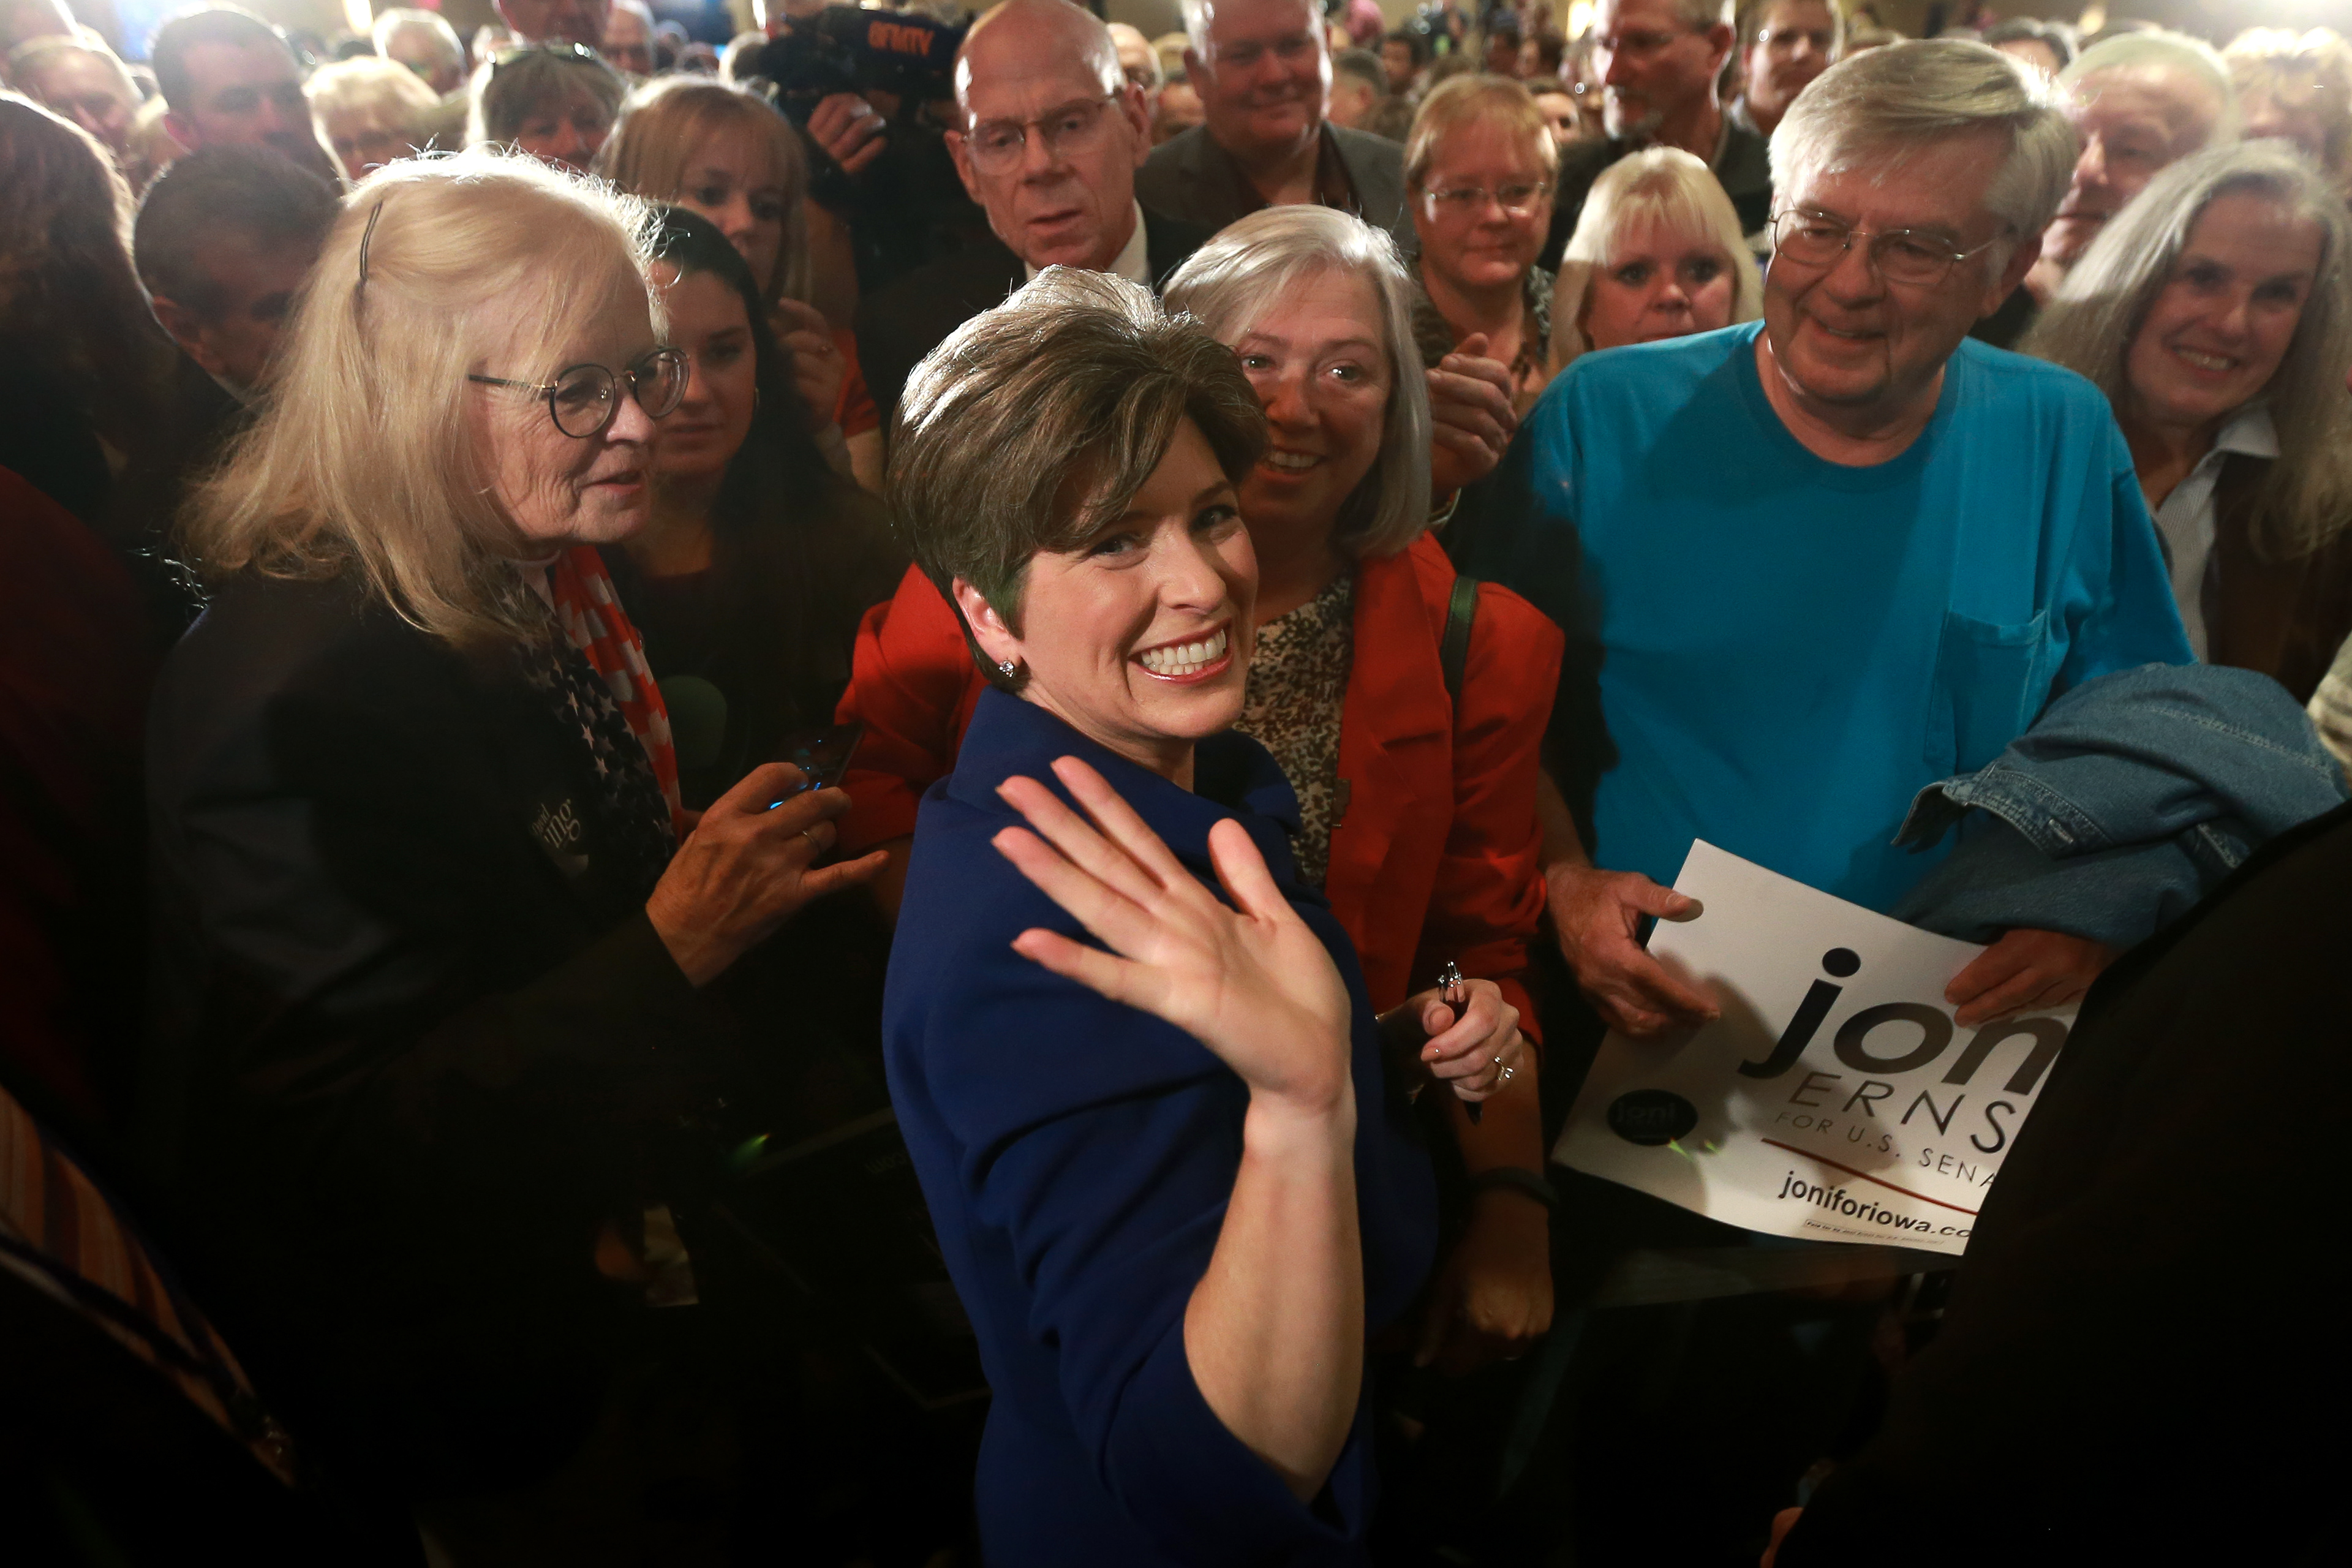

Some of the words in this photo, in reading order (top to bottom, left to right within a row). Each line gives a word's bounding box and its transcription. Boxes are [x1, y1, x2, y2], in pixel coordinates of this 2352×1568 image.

[1737, 947, 2067, 1096] jon
[1776, 1111, 1834, 1134] FOR
[1847, 1125, 1901, 1157] U.S.
[1918, 1147, 1996, 1187] SENA
[1789, 1071, 2016, 1153] ERNS
[1777, 1170, 1972, 1238] joniforiowa.co
